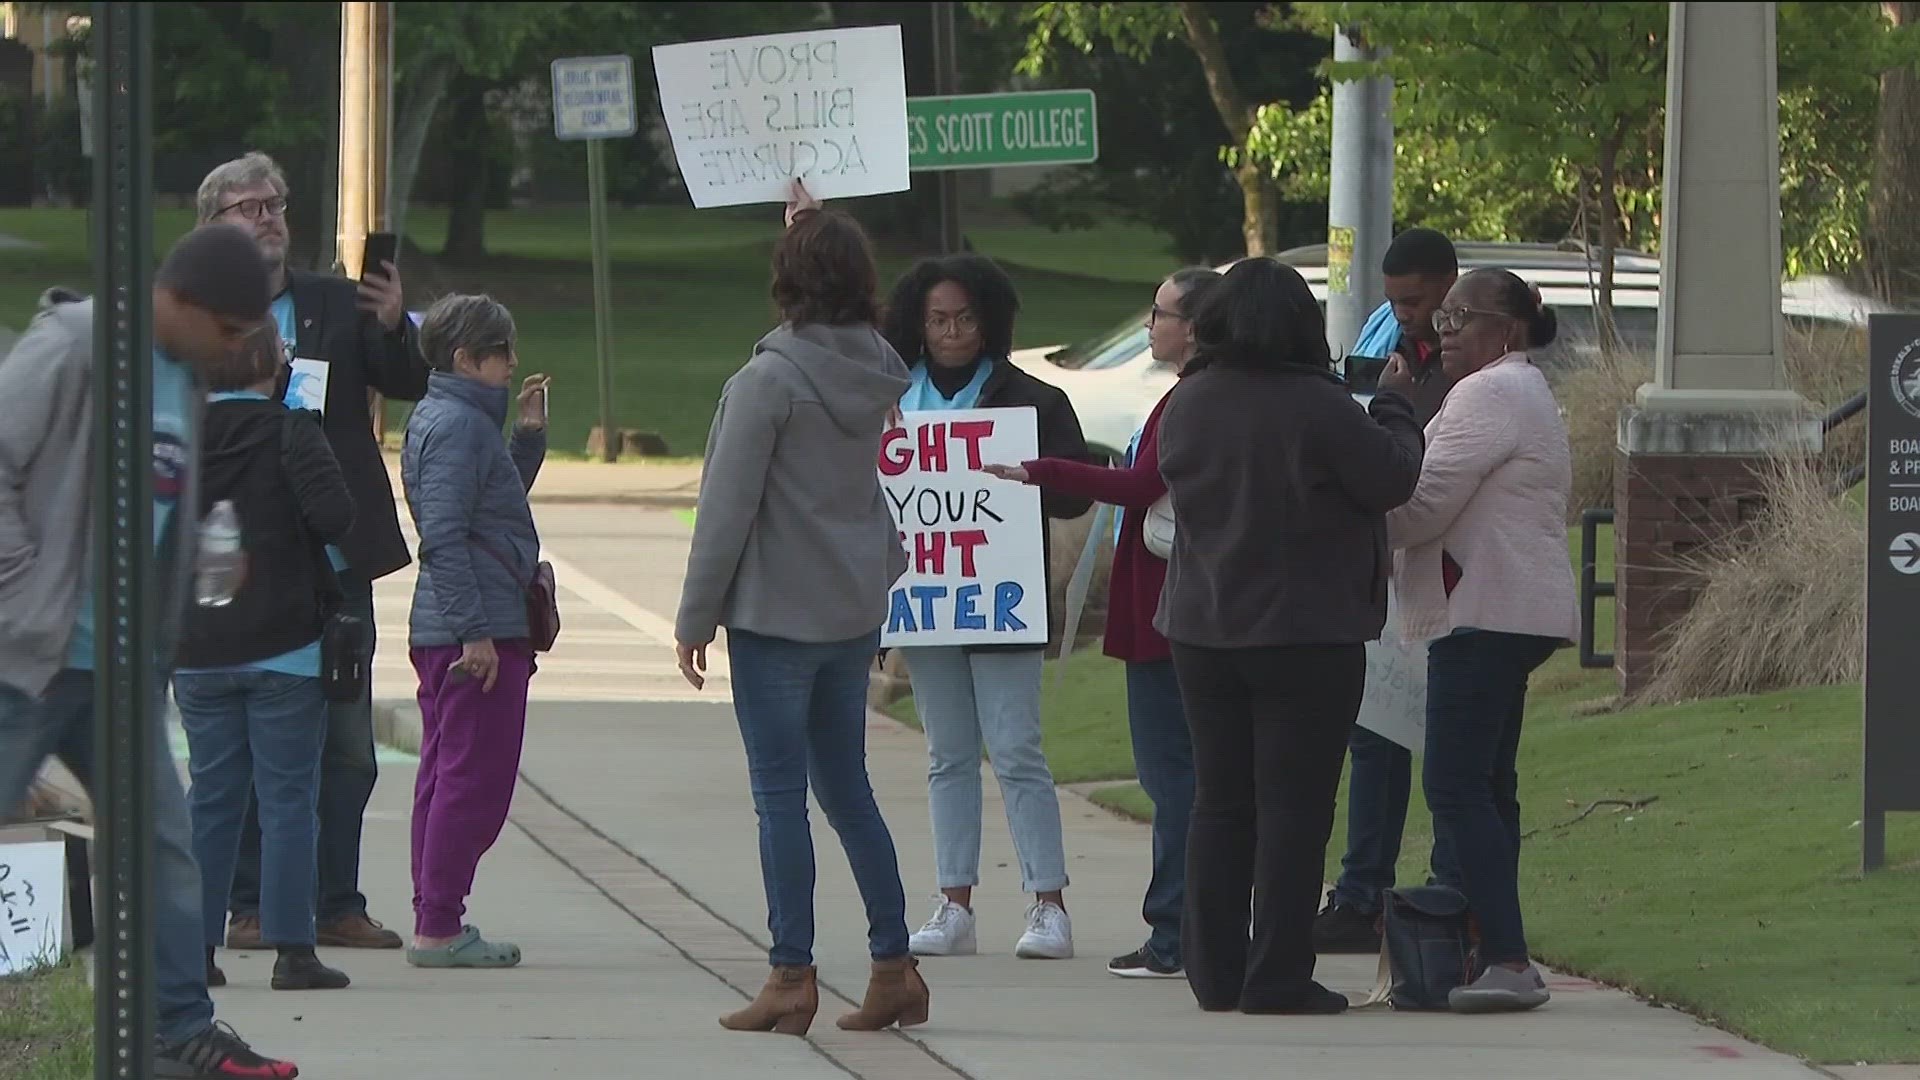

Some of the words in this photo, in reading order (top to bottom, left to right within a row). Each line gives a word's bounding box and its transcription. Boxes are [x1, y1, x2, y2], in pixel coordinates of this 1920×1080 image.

[908, 116, 928, 155] ES
[935, 112, 994, 154] SCOTT
[1002, 107, 1088, 150] COLLEGE
[878, 421, 995, 476] GHT
[1889, 460, 1900, 475] &
[1890, 439, 1920, 454] BOA
[885, 485, 1004, 526] YOUR
[1889, 496, 1920, 511] BOA
[899, 530, 989, 578] HT
[887, 581, 1028, 634] ATER
